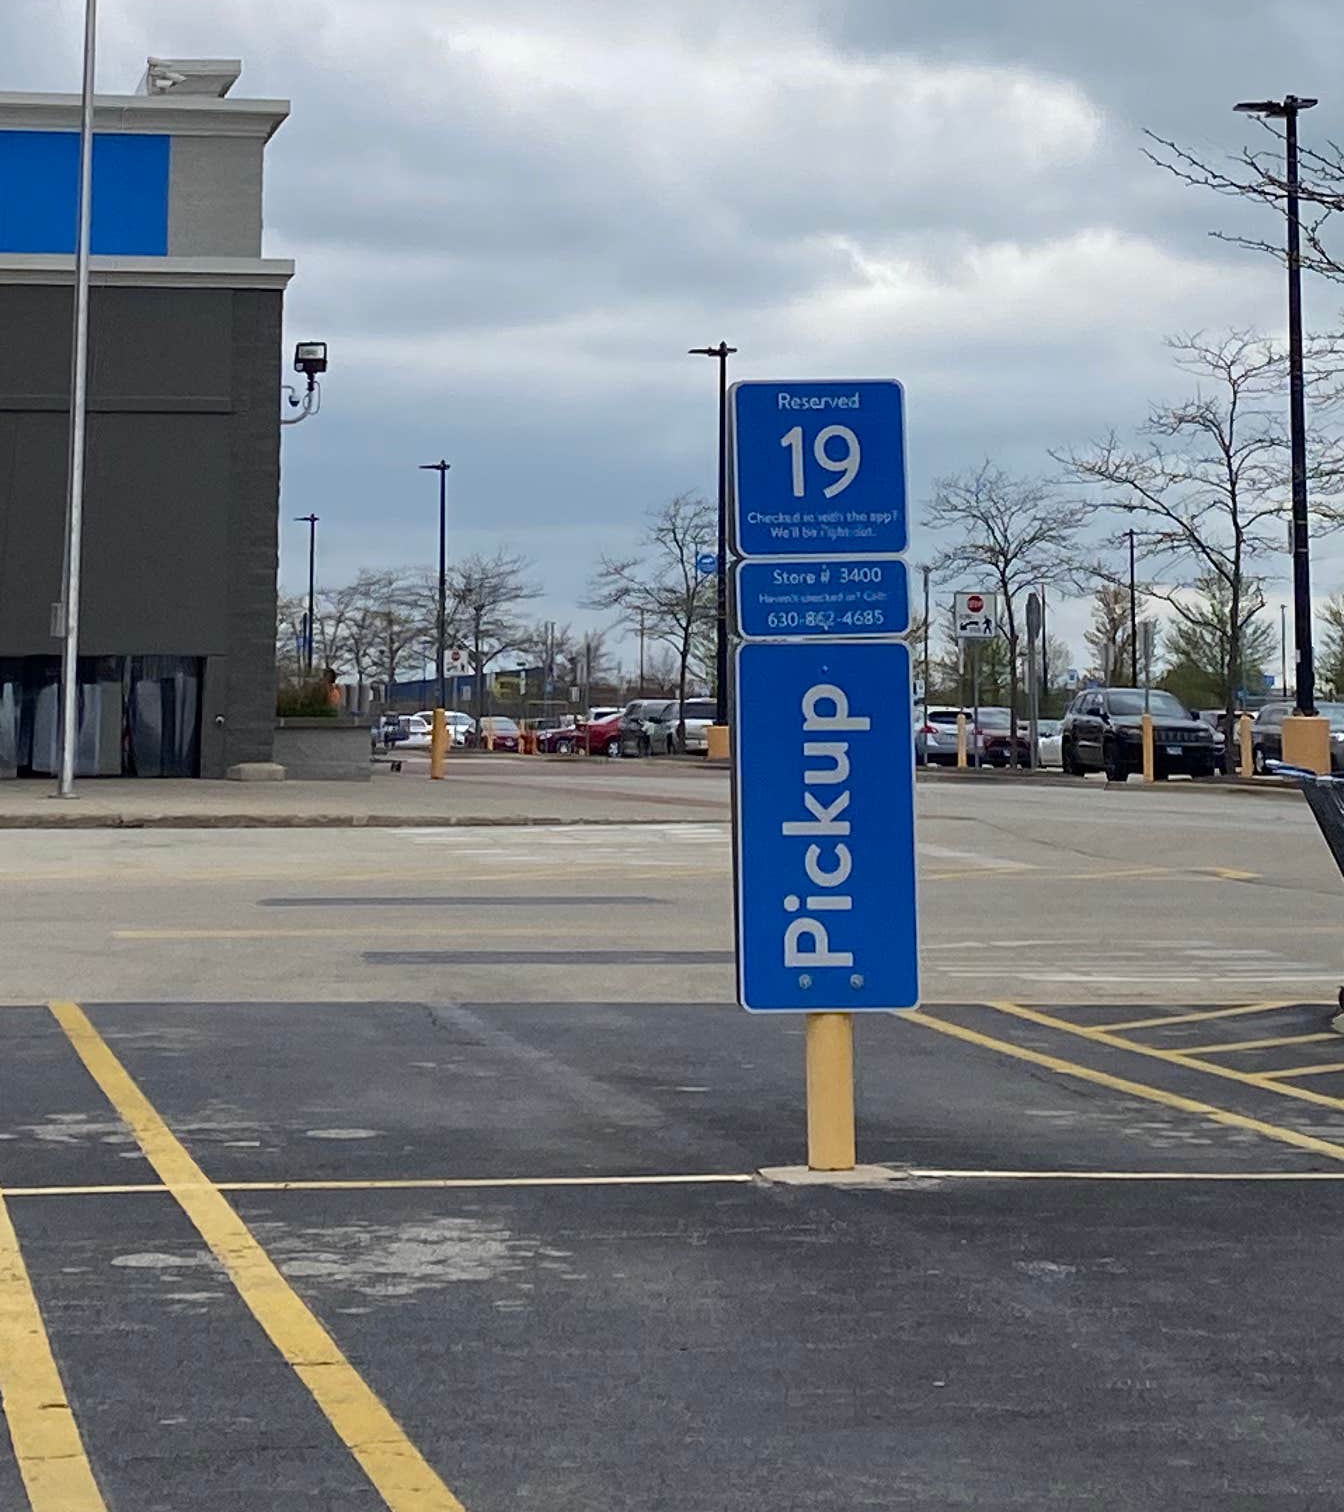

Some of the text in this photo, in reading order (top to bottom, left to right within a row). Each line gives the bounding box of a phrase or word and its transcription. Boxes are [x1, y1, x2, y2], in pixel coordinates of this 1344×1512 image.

[777, 392, 860, 410] Reserved
[780, 424, 861, 499] 19
[747, 510, 898, 525] Checked in with the app?
[770, 526, 799, 538] We'll
[801, 526, 817, 538] be
[772, 567, 882, 585] Store # 3400
[767, 609, 885, 628] 630-862-4685
[782, 683, 871, 968] Pickup
